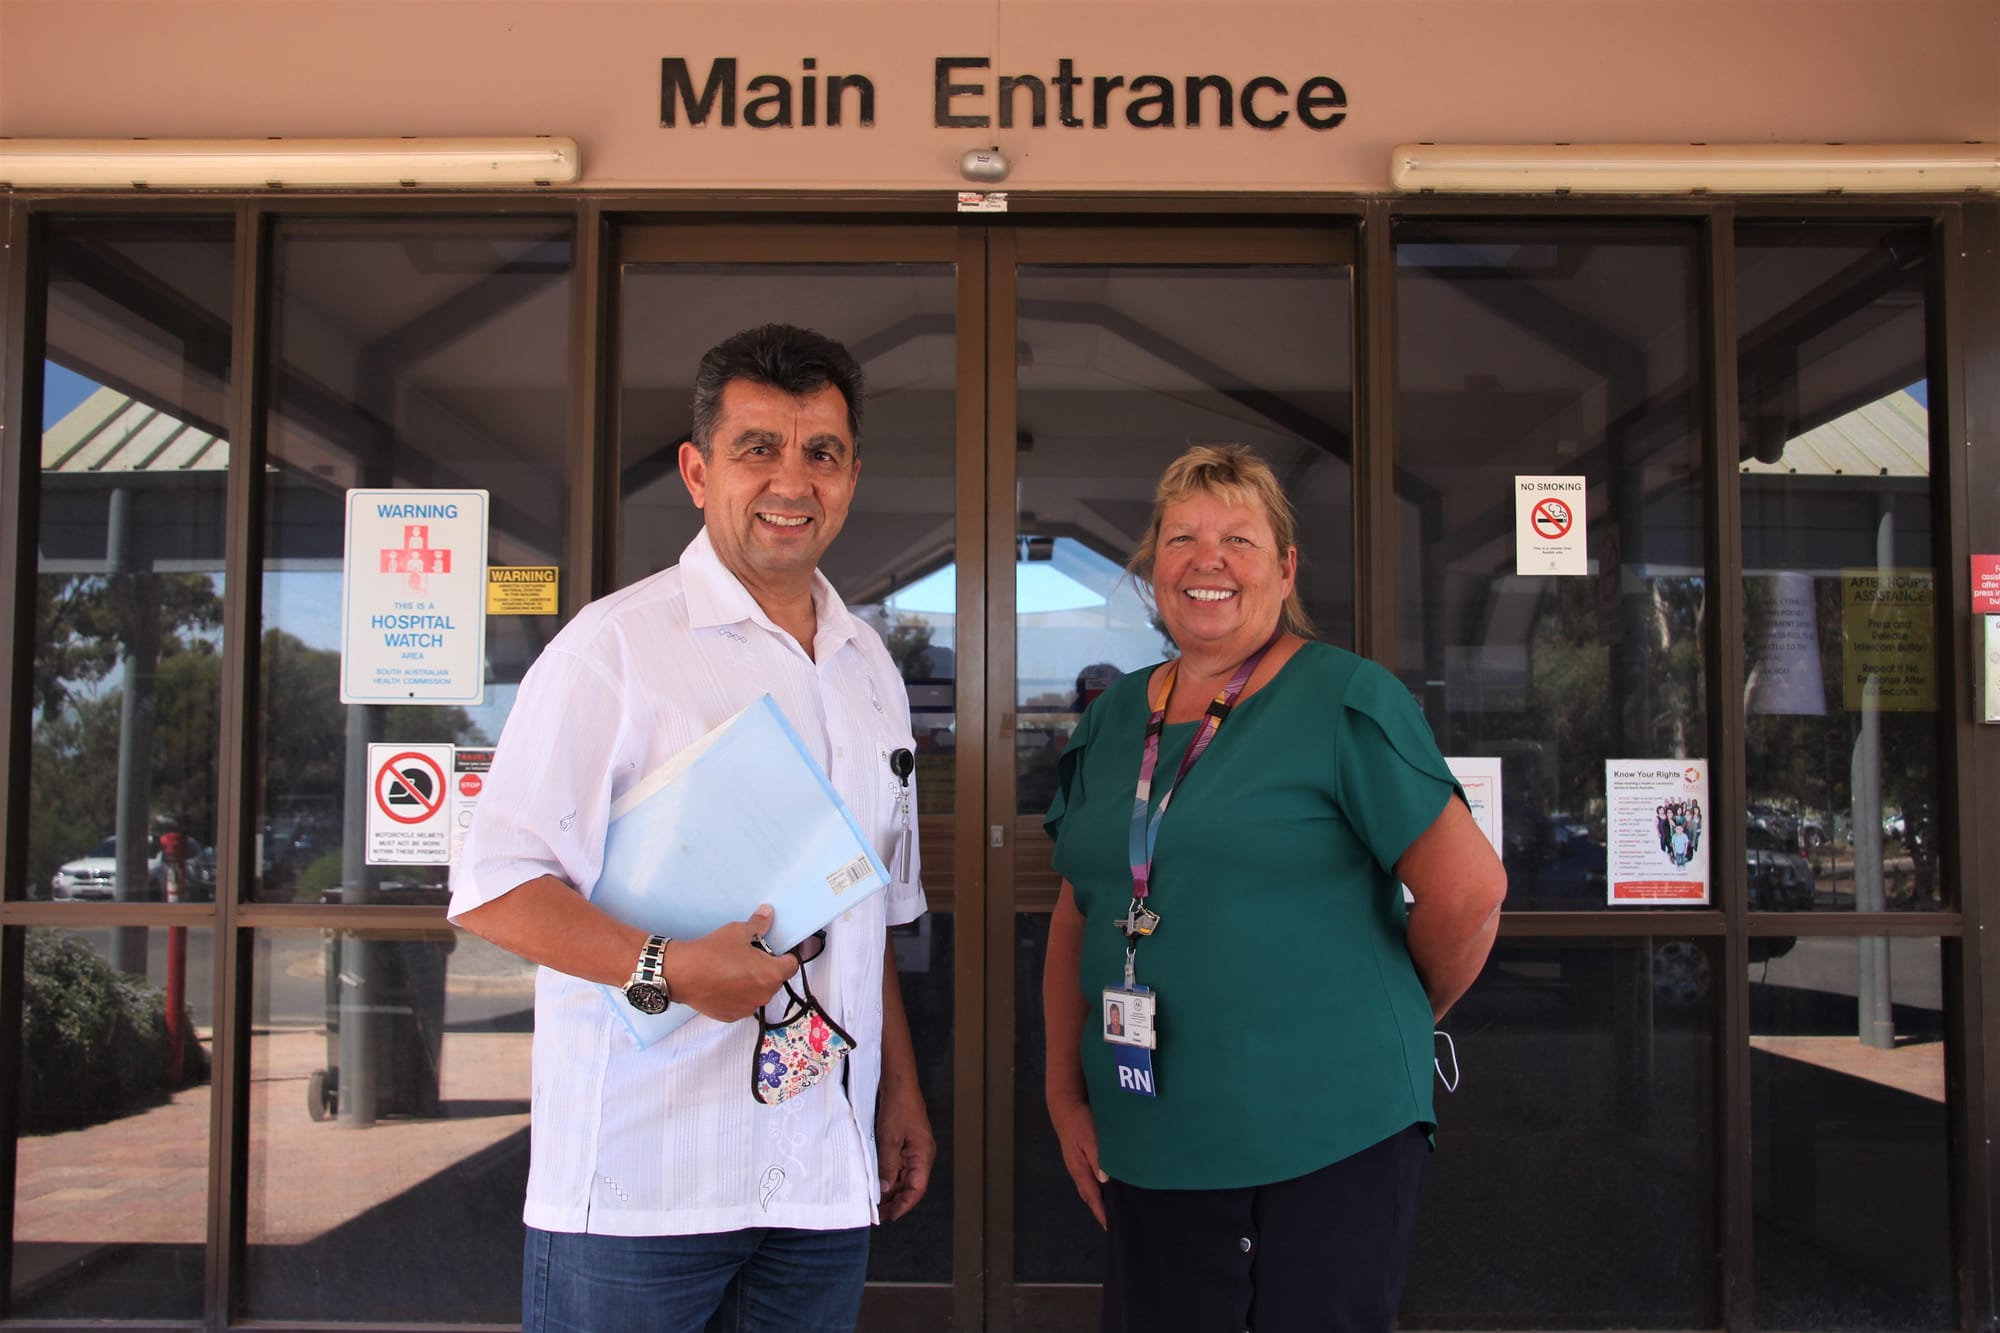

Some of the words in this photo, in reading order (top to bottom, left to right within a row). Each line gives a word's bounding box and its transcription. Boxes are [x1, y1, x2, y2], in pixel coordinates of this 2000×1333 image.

[659, 57, 875, 130] Main
[933, 57, 1349, 131] Entrance
[1520, 482, 1535, 492] NO
[1537, 482, 1582, 492] SMOKING
[377, 504, 458, 519] WARNING
[491, 570, 554, 582] WARNING
[1850, 576, 1885, 589] AFTE
[1981, 581, 1999, 589] after
[1854, 590, 1926, 602] ASSSTANCE
[1974, 590, 1994, 598] press
[394, 602, 413, 610] THIS
[416, 602, 425, 610] IS
[371, 615, 455, 630] HOSPITAL
[384, 633, 443, 648] WATCH
[401, 652, 424, 660] AREA
[376, 668, 401, 676] SOUTH
[404, 668, 449, 676] AUSTRALIAN
[373, 677, 401, 685] HEALTH
[403, 677, 451, 685] COMMISSION
[1614, 770, 1635, 779] Know
[1637, 770, 1654, 779] Your
[1656, 770, 1681, 781] Rights
[460, 781, 481, 789] STOP
[1117, 1064, 1152, 1094] RN
